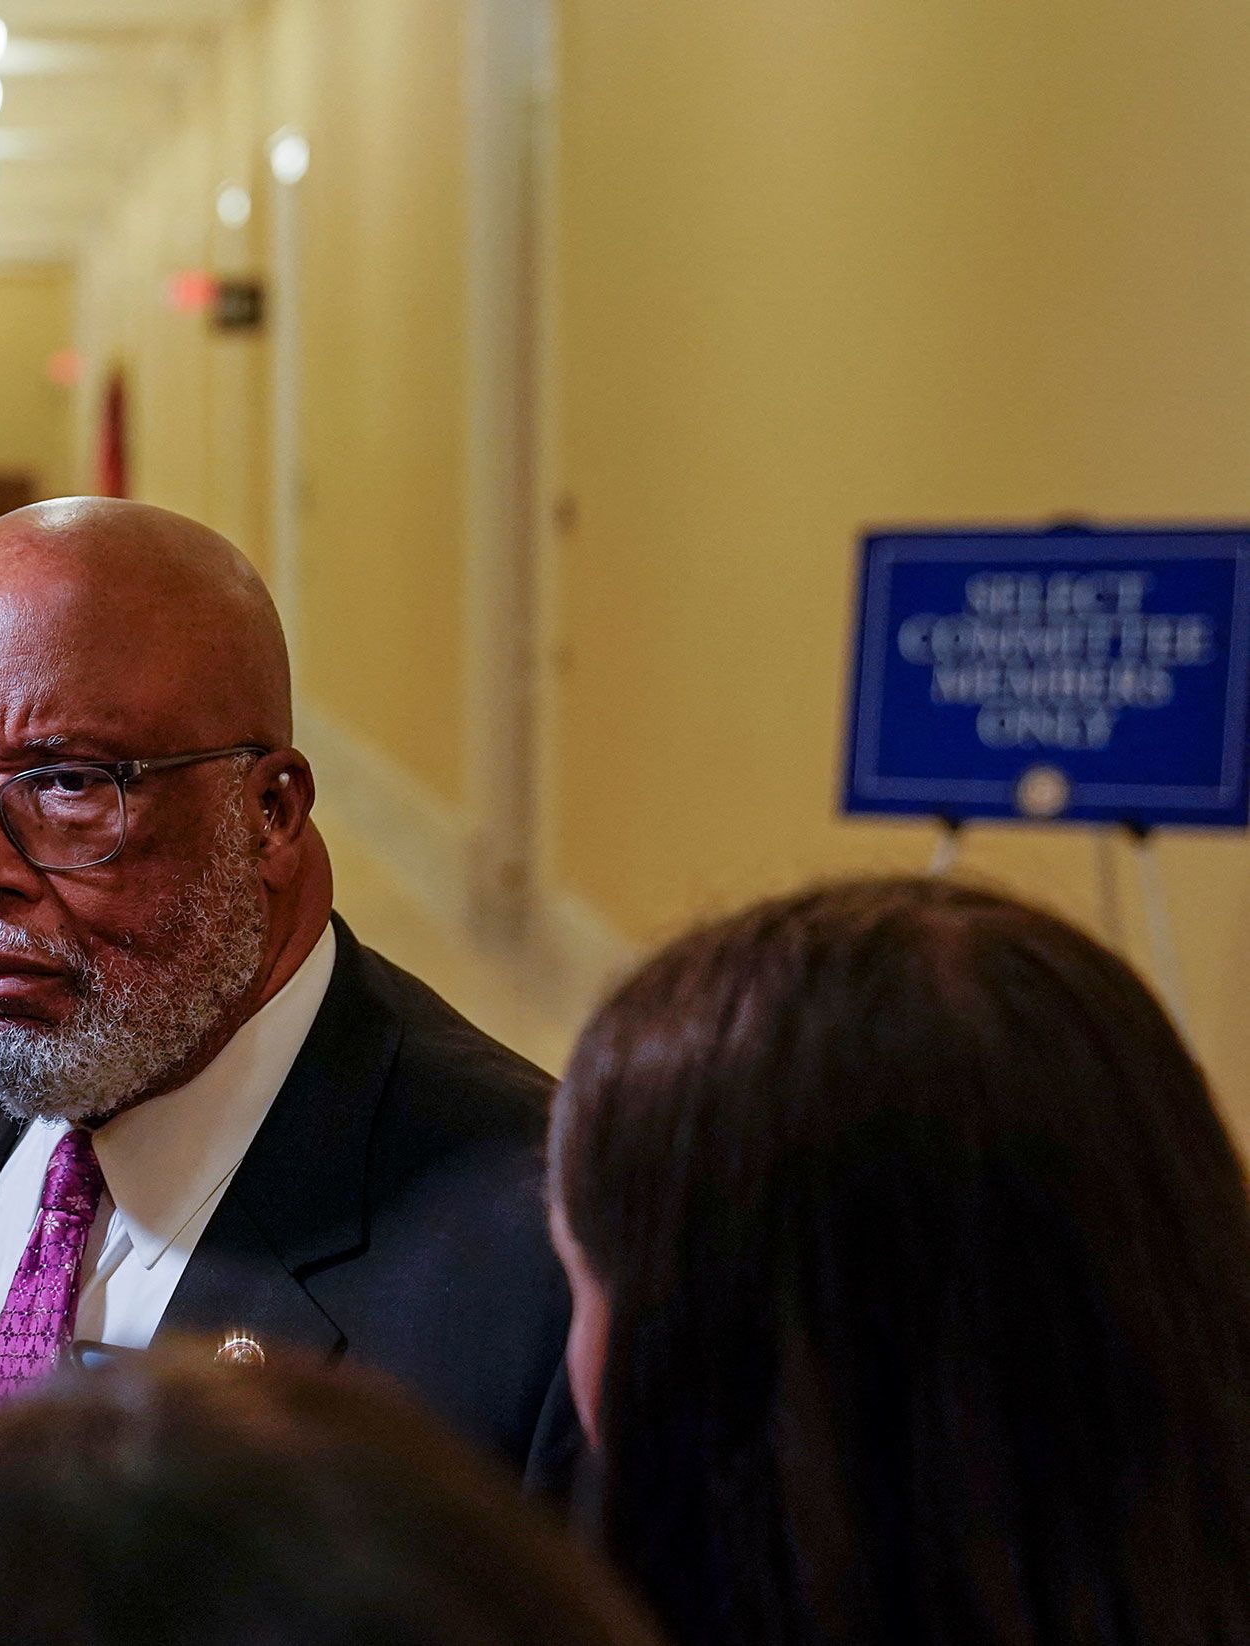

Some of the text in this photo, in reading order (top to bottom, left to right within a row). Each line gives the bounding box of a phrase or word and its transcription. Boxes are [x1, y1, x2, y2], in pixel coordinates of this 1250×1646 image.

[966, 571, 1153, 615] SELECT
[899, 614, 1212, 665] COMMITTEE
[932, 660, 1173, 706] MEMBERS
[977, 703, 1117, 749] ONLY
